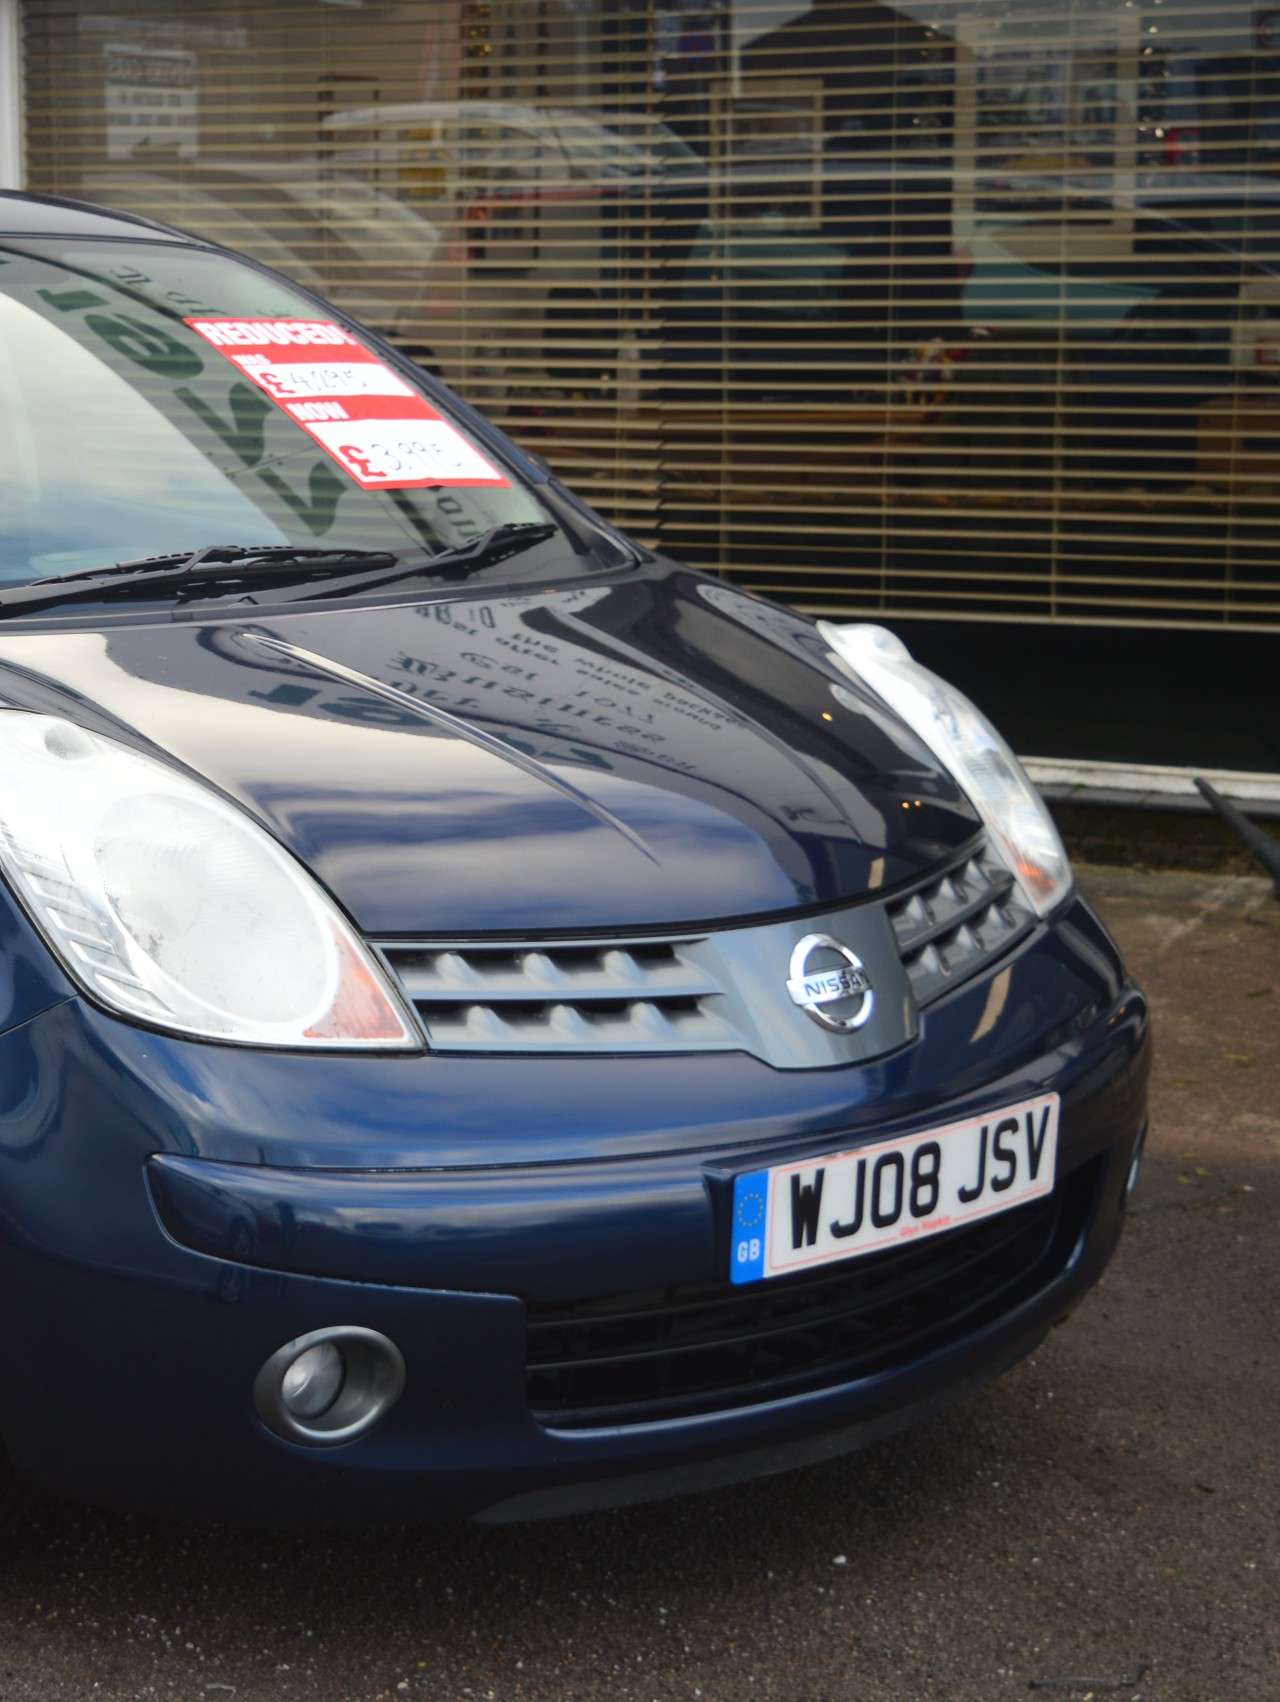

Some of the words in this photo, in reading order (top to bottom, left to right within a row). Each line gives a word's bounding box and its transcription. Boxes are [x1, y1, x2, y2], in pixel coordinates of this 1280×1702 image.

[192, 319, 357, 347] REDUCED!
[284, 400, 351, 422] NOW
[736, 1237, 761, 1264] GB
[789, 1140, 942, 1250] WJ08
[957, 1104, 1051, 1204] JSV
